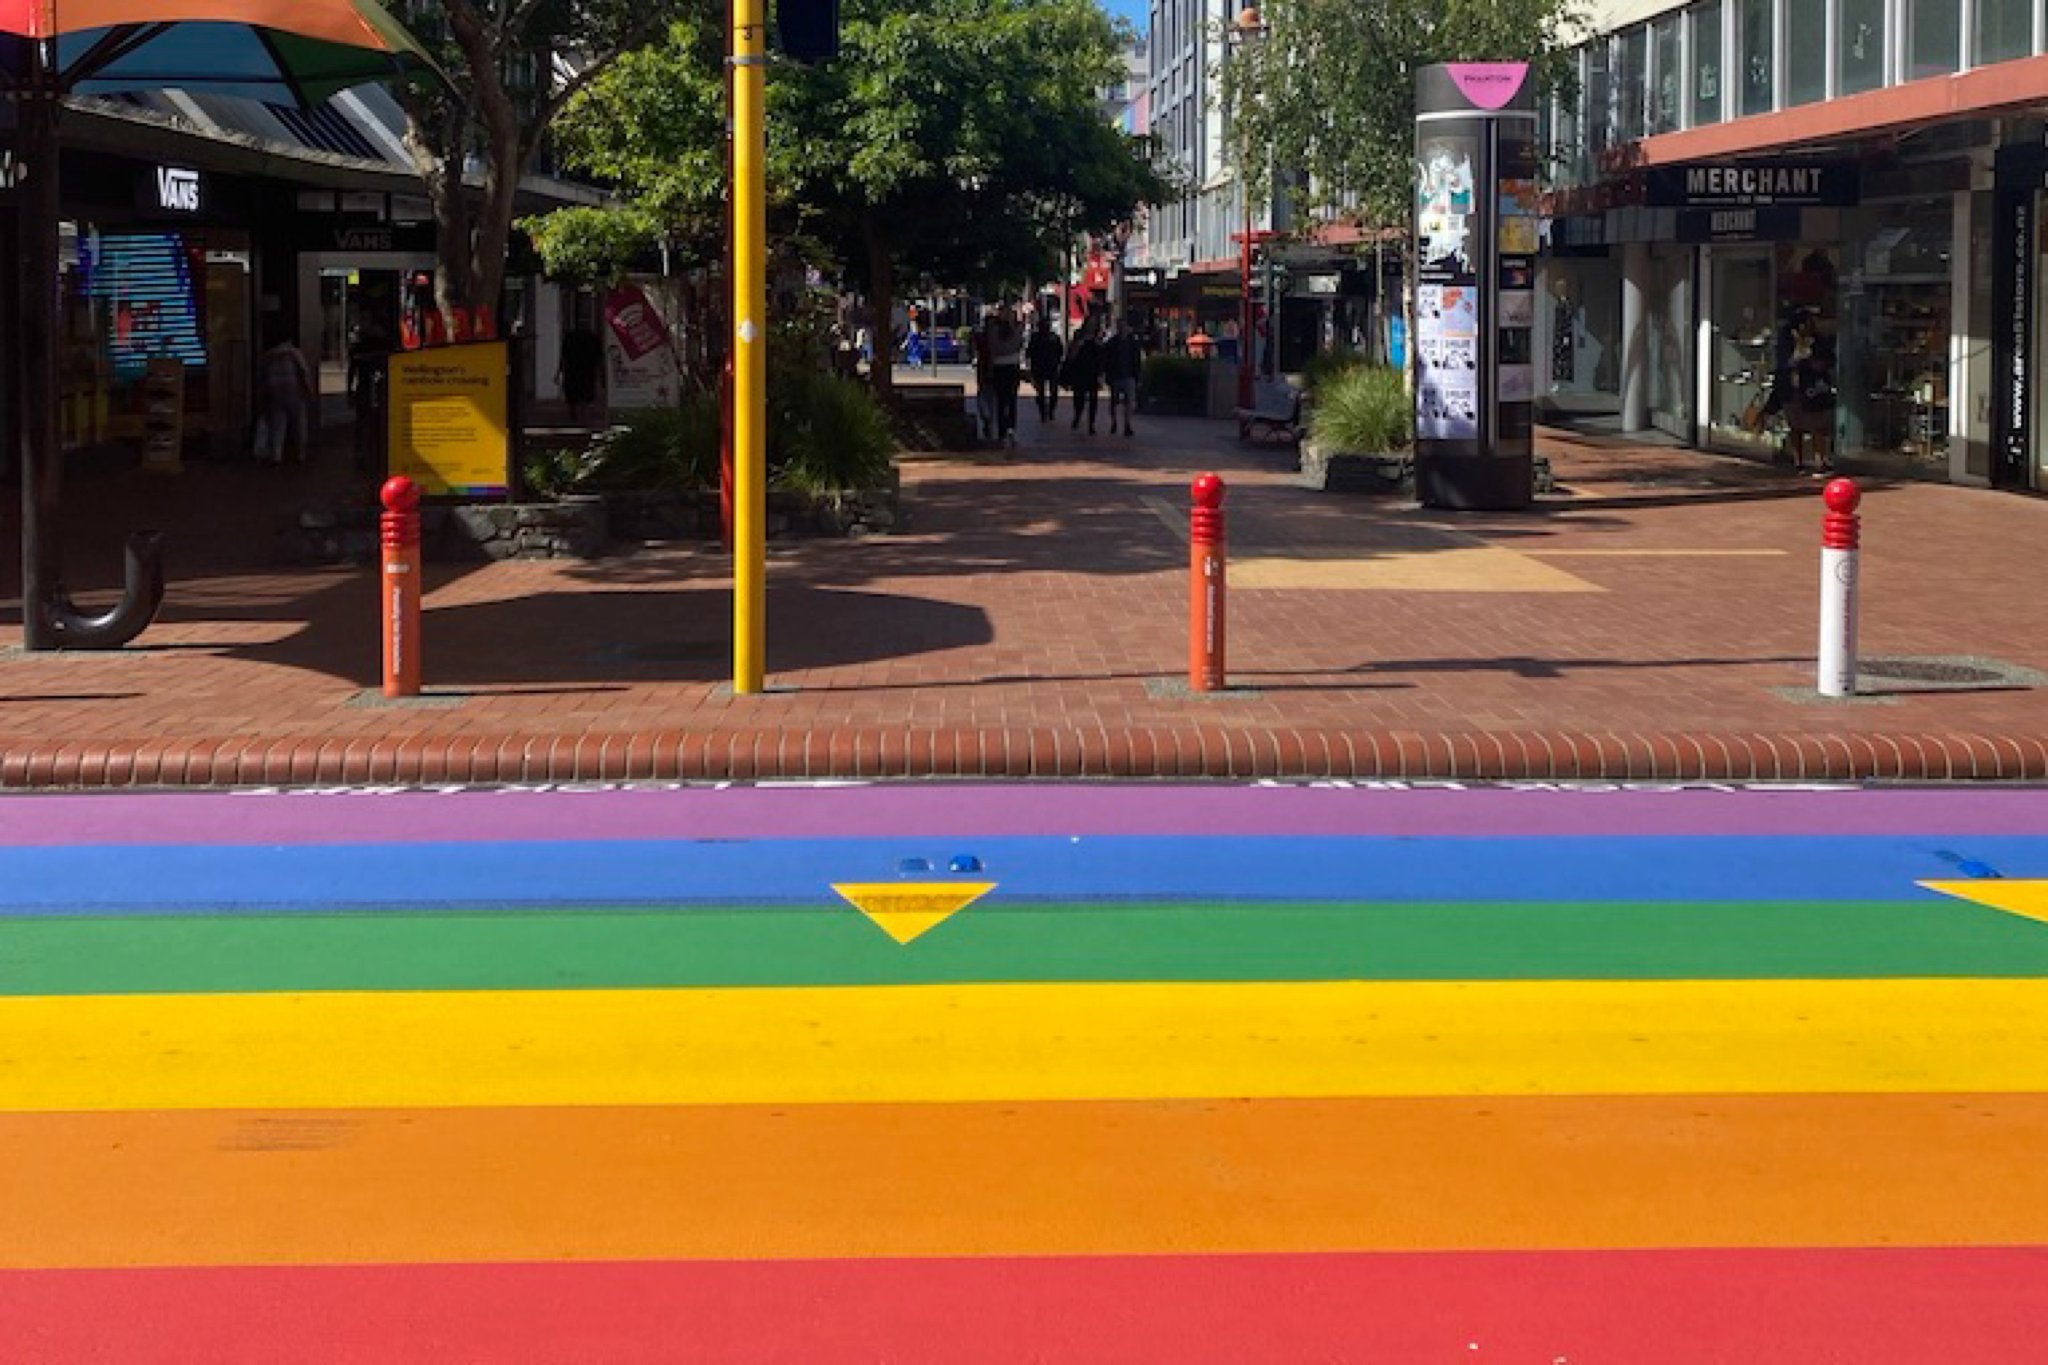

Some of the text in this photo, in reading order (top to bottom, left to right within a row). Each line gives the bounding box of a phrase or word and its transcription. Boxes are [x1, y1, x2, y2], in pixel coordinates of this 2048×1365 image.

[157, 165, 199, 210] VANS
[1686, 168, 1822, 194] MERCHANT
[334, 226, 392, 250] VANS
